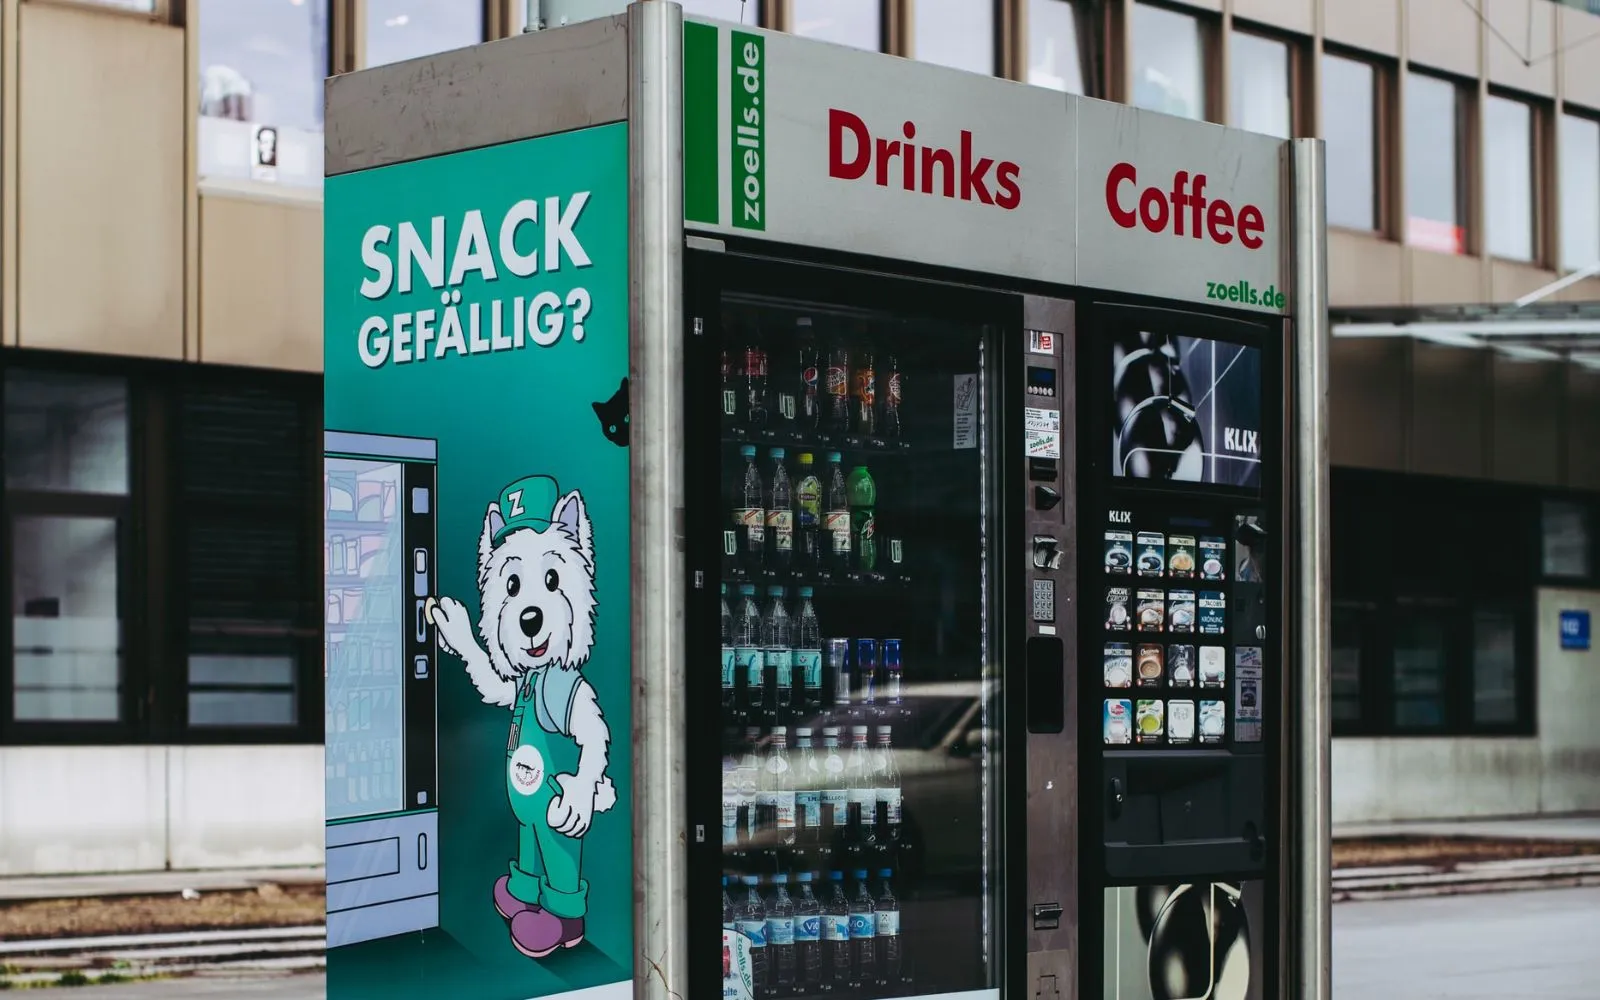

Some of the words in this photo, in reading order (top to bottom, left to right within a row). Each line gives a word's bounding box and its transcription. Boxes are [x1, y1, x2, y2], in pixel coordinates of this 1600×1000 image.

[737, 40, 760, 223] zoells.de
[828, 108, 1021, 210] Drinks
[359, 191, 593, 300] SNACK
[1105, 162, 1265, 249] Coffee
[357, 287, 592, 369] GEFÄLLIG?
[1206, 278, 1286, 310] zoells.de
[1223, 426, 1259, 454] KLIX
[508, 489, 525, 518] Z
[1108, 510, 1132, 524] KLIX
